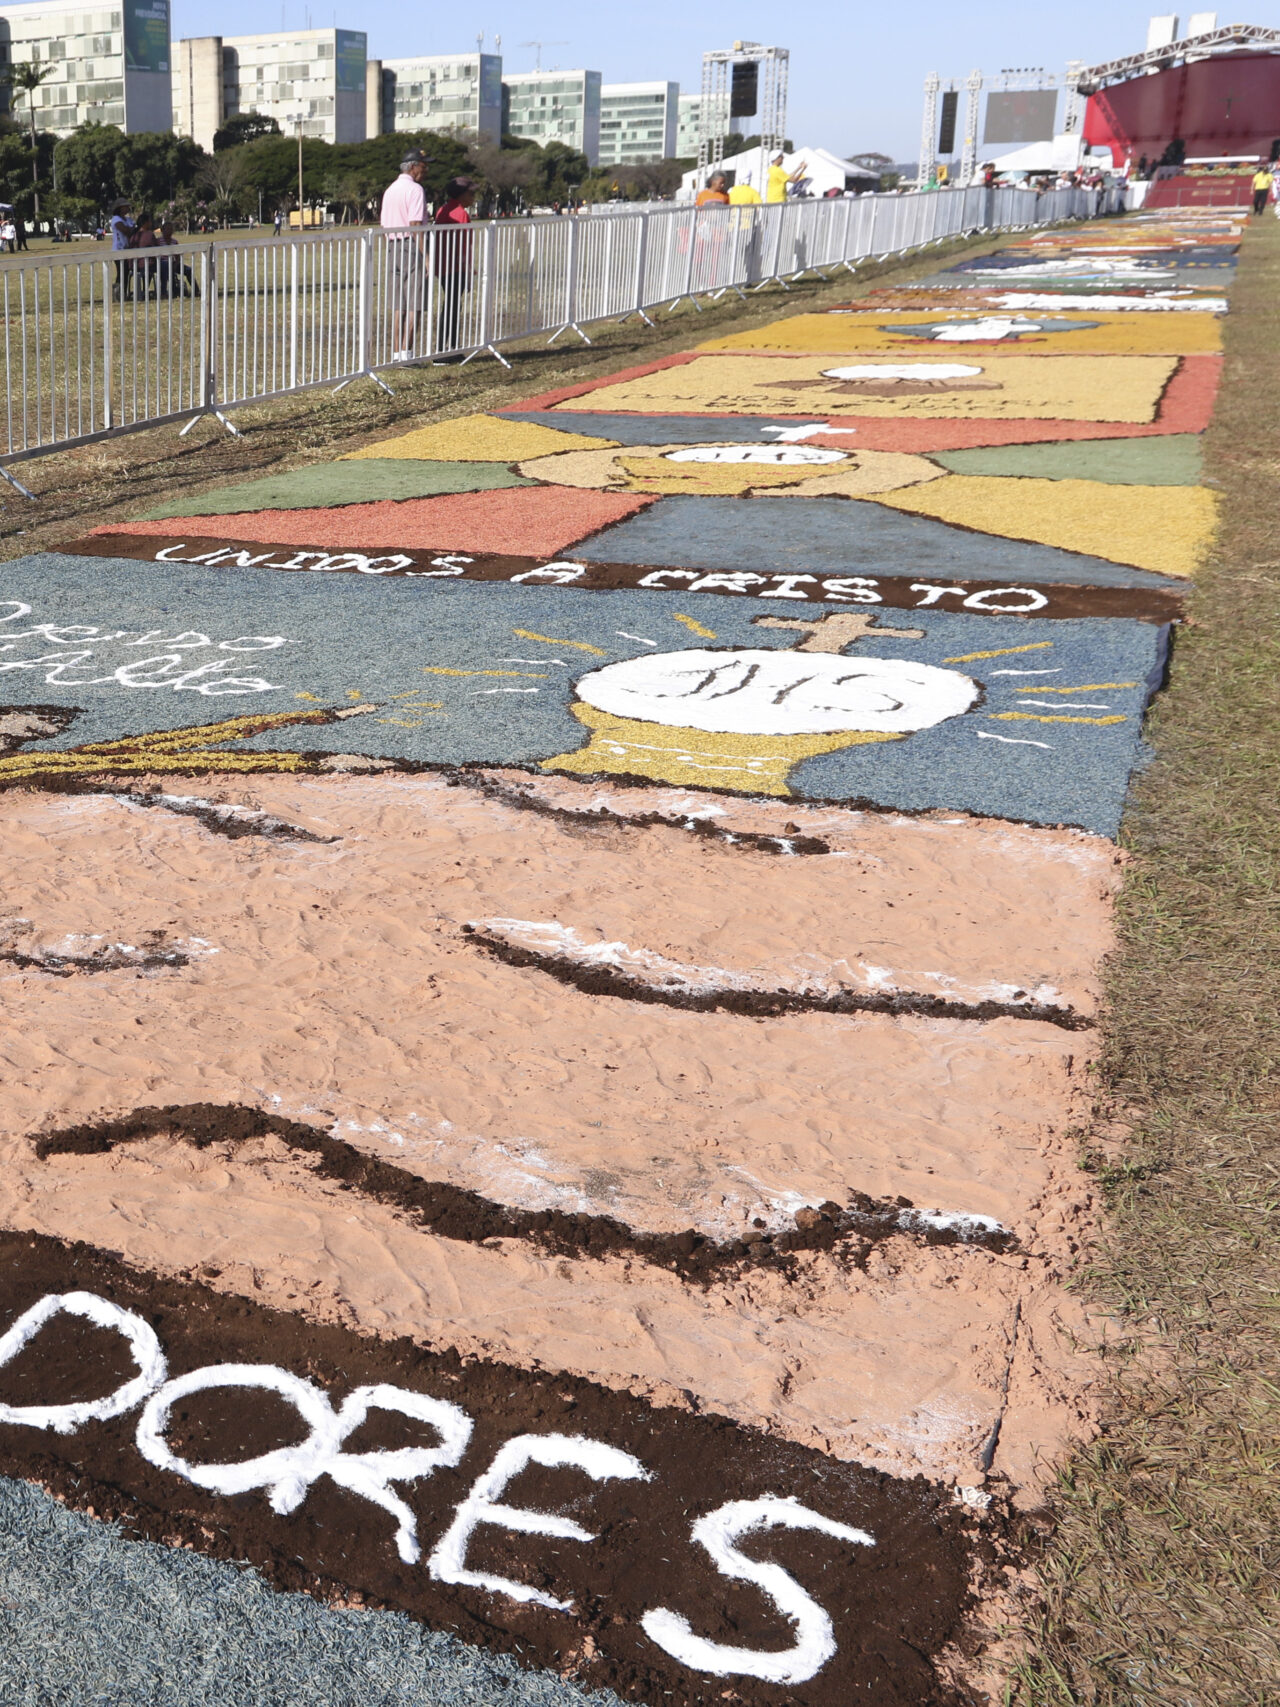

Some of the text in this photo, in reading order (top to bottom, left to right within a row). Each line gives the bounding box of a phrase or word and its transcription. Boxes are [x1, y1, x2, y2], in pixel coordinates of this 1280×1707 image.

[155, 543, 1050, 613] UNIDOS A CRISTO
